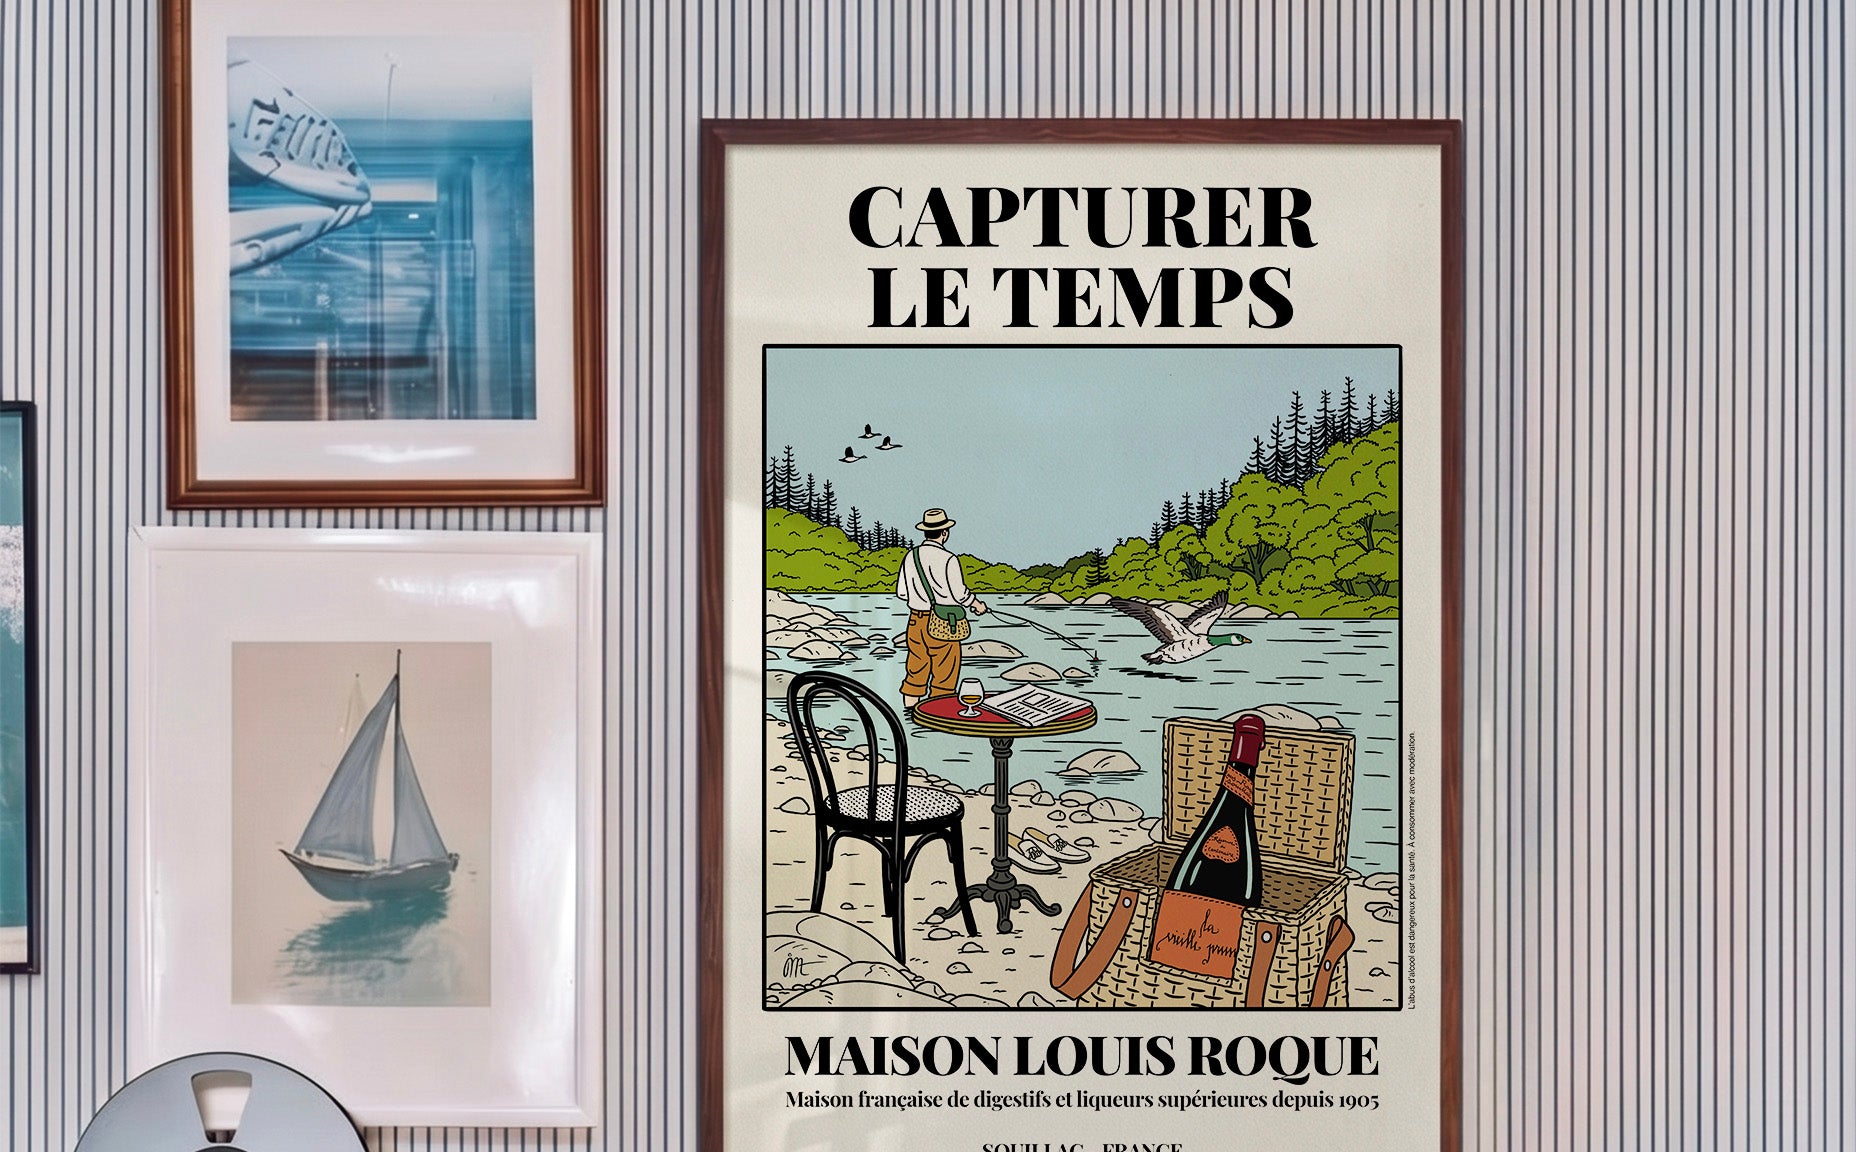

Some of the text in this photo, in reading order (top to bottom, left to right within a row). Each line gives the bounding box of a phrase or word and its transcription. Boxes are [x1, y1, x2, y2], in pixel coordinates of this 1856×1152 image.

[849, 185, 1318, 249] CAPTURER
[867, 266, 1294, 329] LE TEMPS
[1408, 776, 1416, 795] avec
[1408, 795, 1416, 841] consommer
[1407, 873, 1416, 881] la
[1409, 882, 1418, 900] pour
[1408, 901, 1418, 941] dangereux
[1408, 941, 1416, 954] est
[1407, 955, 1416, 983] d'alcool
[1407, 984, 1416, 1010] L'abus
[785, 1035, 1379, 1086] MAISON LOUIS ROQUE
[785, 1089, 1380, 1112] Maison française de digestifs et liqueurs supérieures depuis 1905
